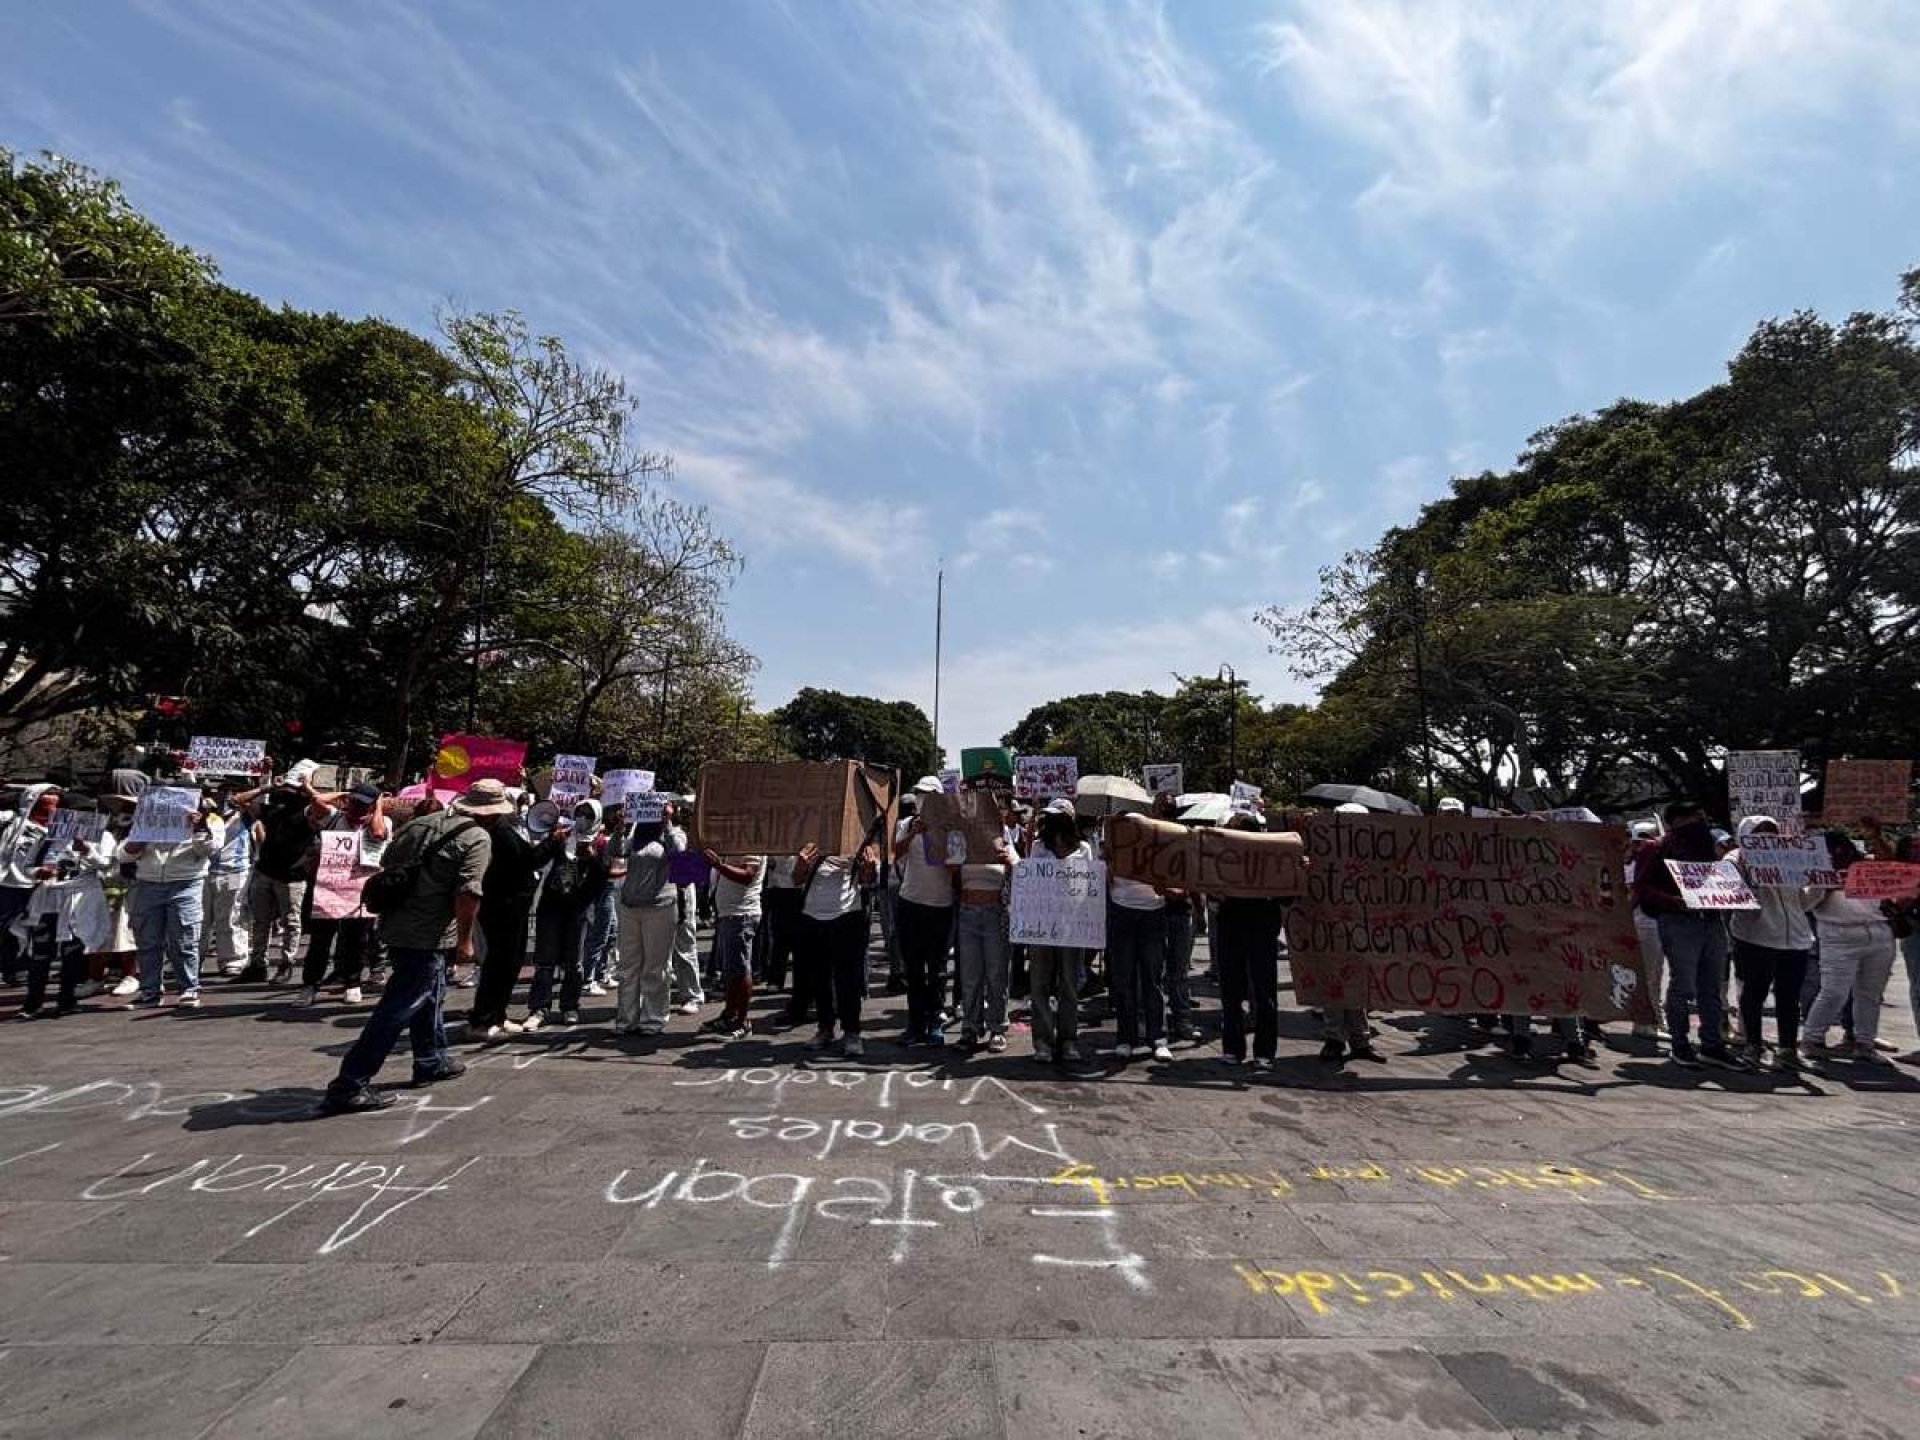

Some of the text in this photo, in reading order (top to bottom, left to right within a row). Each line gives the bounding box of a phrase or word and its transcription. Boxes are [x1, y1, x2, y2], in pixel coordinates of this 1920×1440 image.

[1036, 861, 1054, 879] NO
[1111, 818, 1187, 882] Puta
[1436, 879, 1487, 912] para
[1286, 904, 1454, 960] Condenas
[1366, 962, 1505, 1011] ACOSO
[674, 1067, 1049, 1113] Violador
[727, 1114, 1078, 1167] Morales
[80, 1153, 479, 1253] Adrian
[604, 1158, 1153, 1296] Esteban
